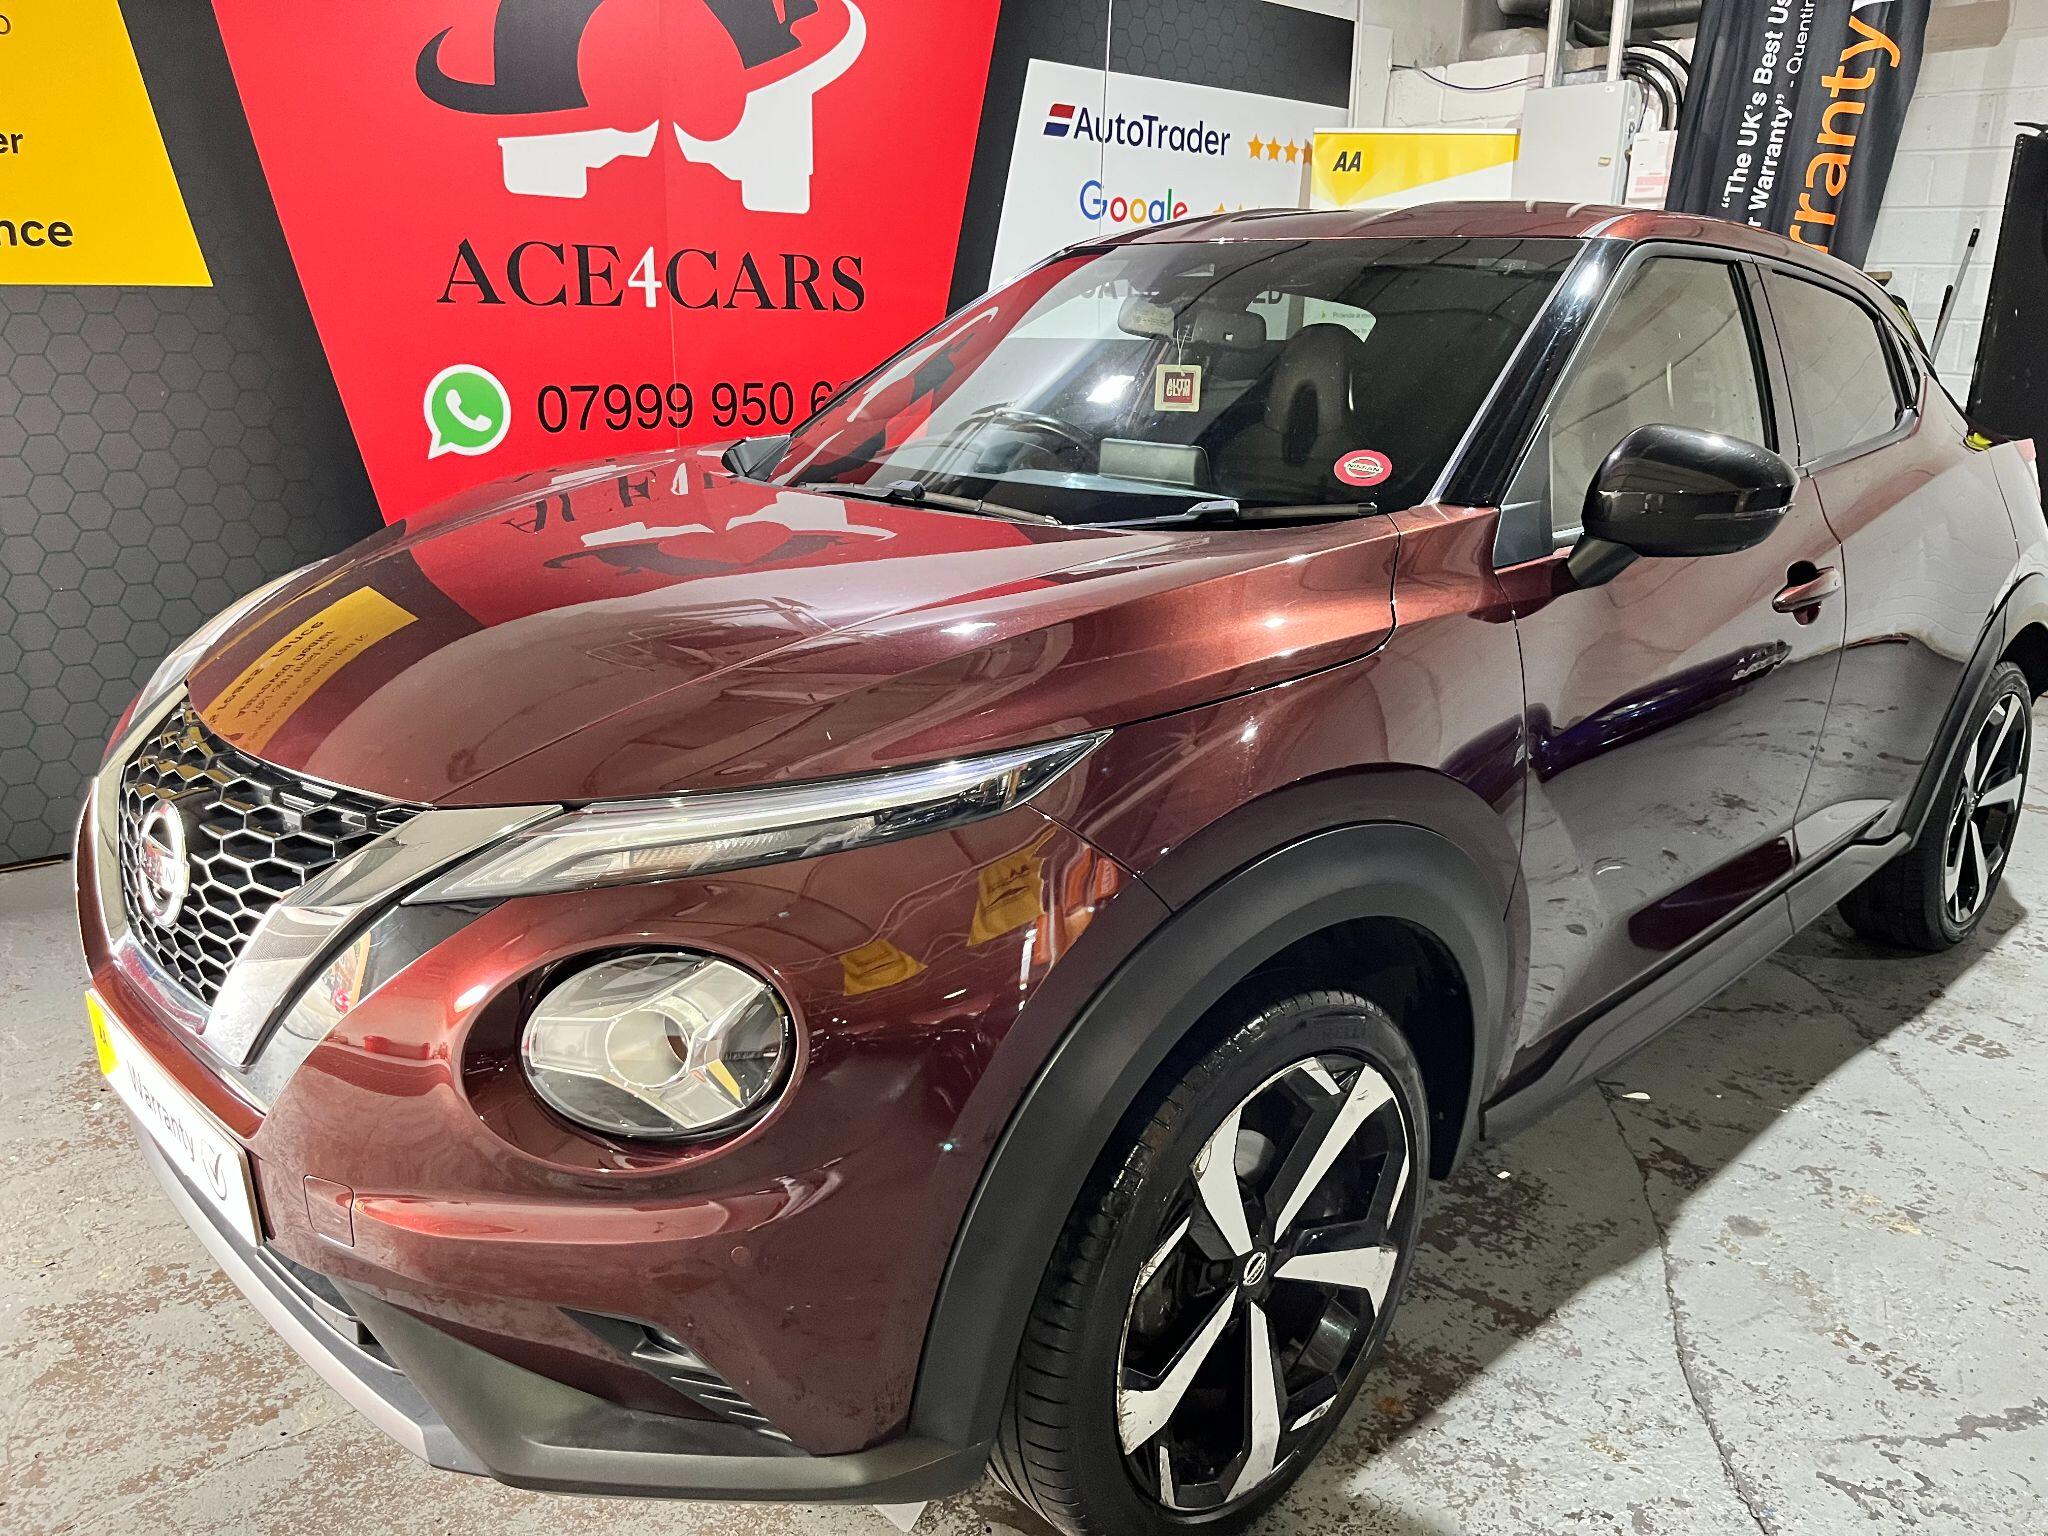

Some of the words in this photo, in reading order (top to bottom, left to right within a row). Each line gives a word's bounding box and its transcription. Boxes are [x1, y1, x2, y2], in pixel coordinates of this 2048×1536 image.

[1753, 30, 1784, 86] Best
[1073, 106, 1231, 156] AutoTrader
[1332, 151, 1362, 172] AA
[437, 238, 866, 313] ACE4CARS
[537, 383, 693, 434] 07999
[711, 381, 794, 427] 950
